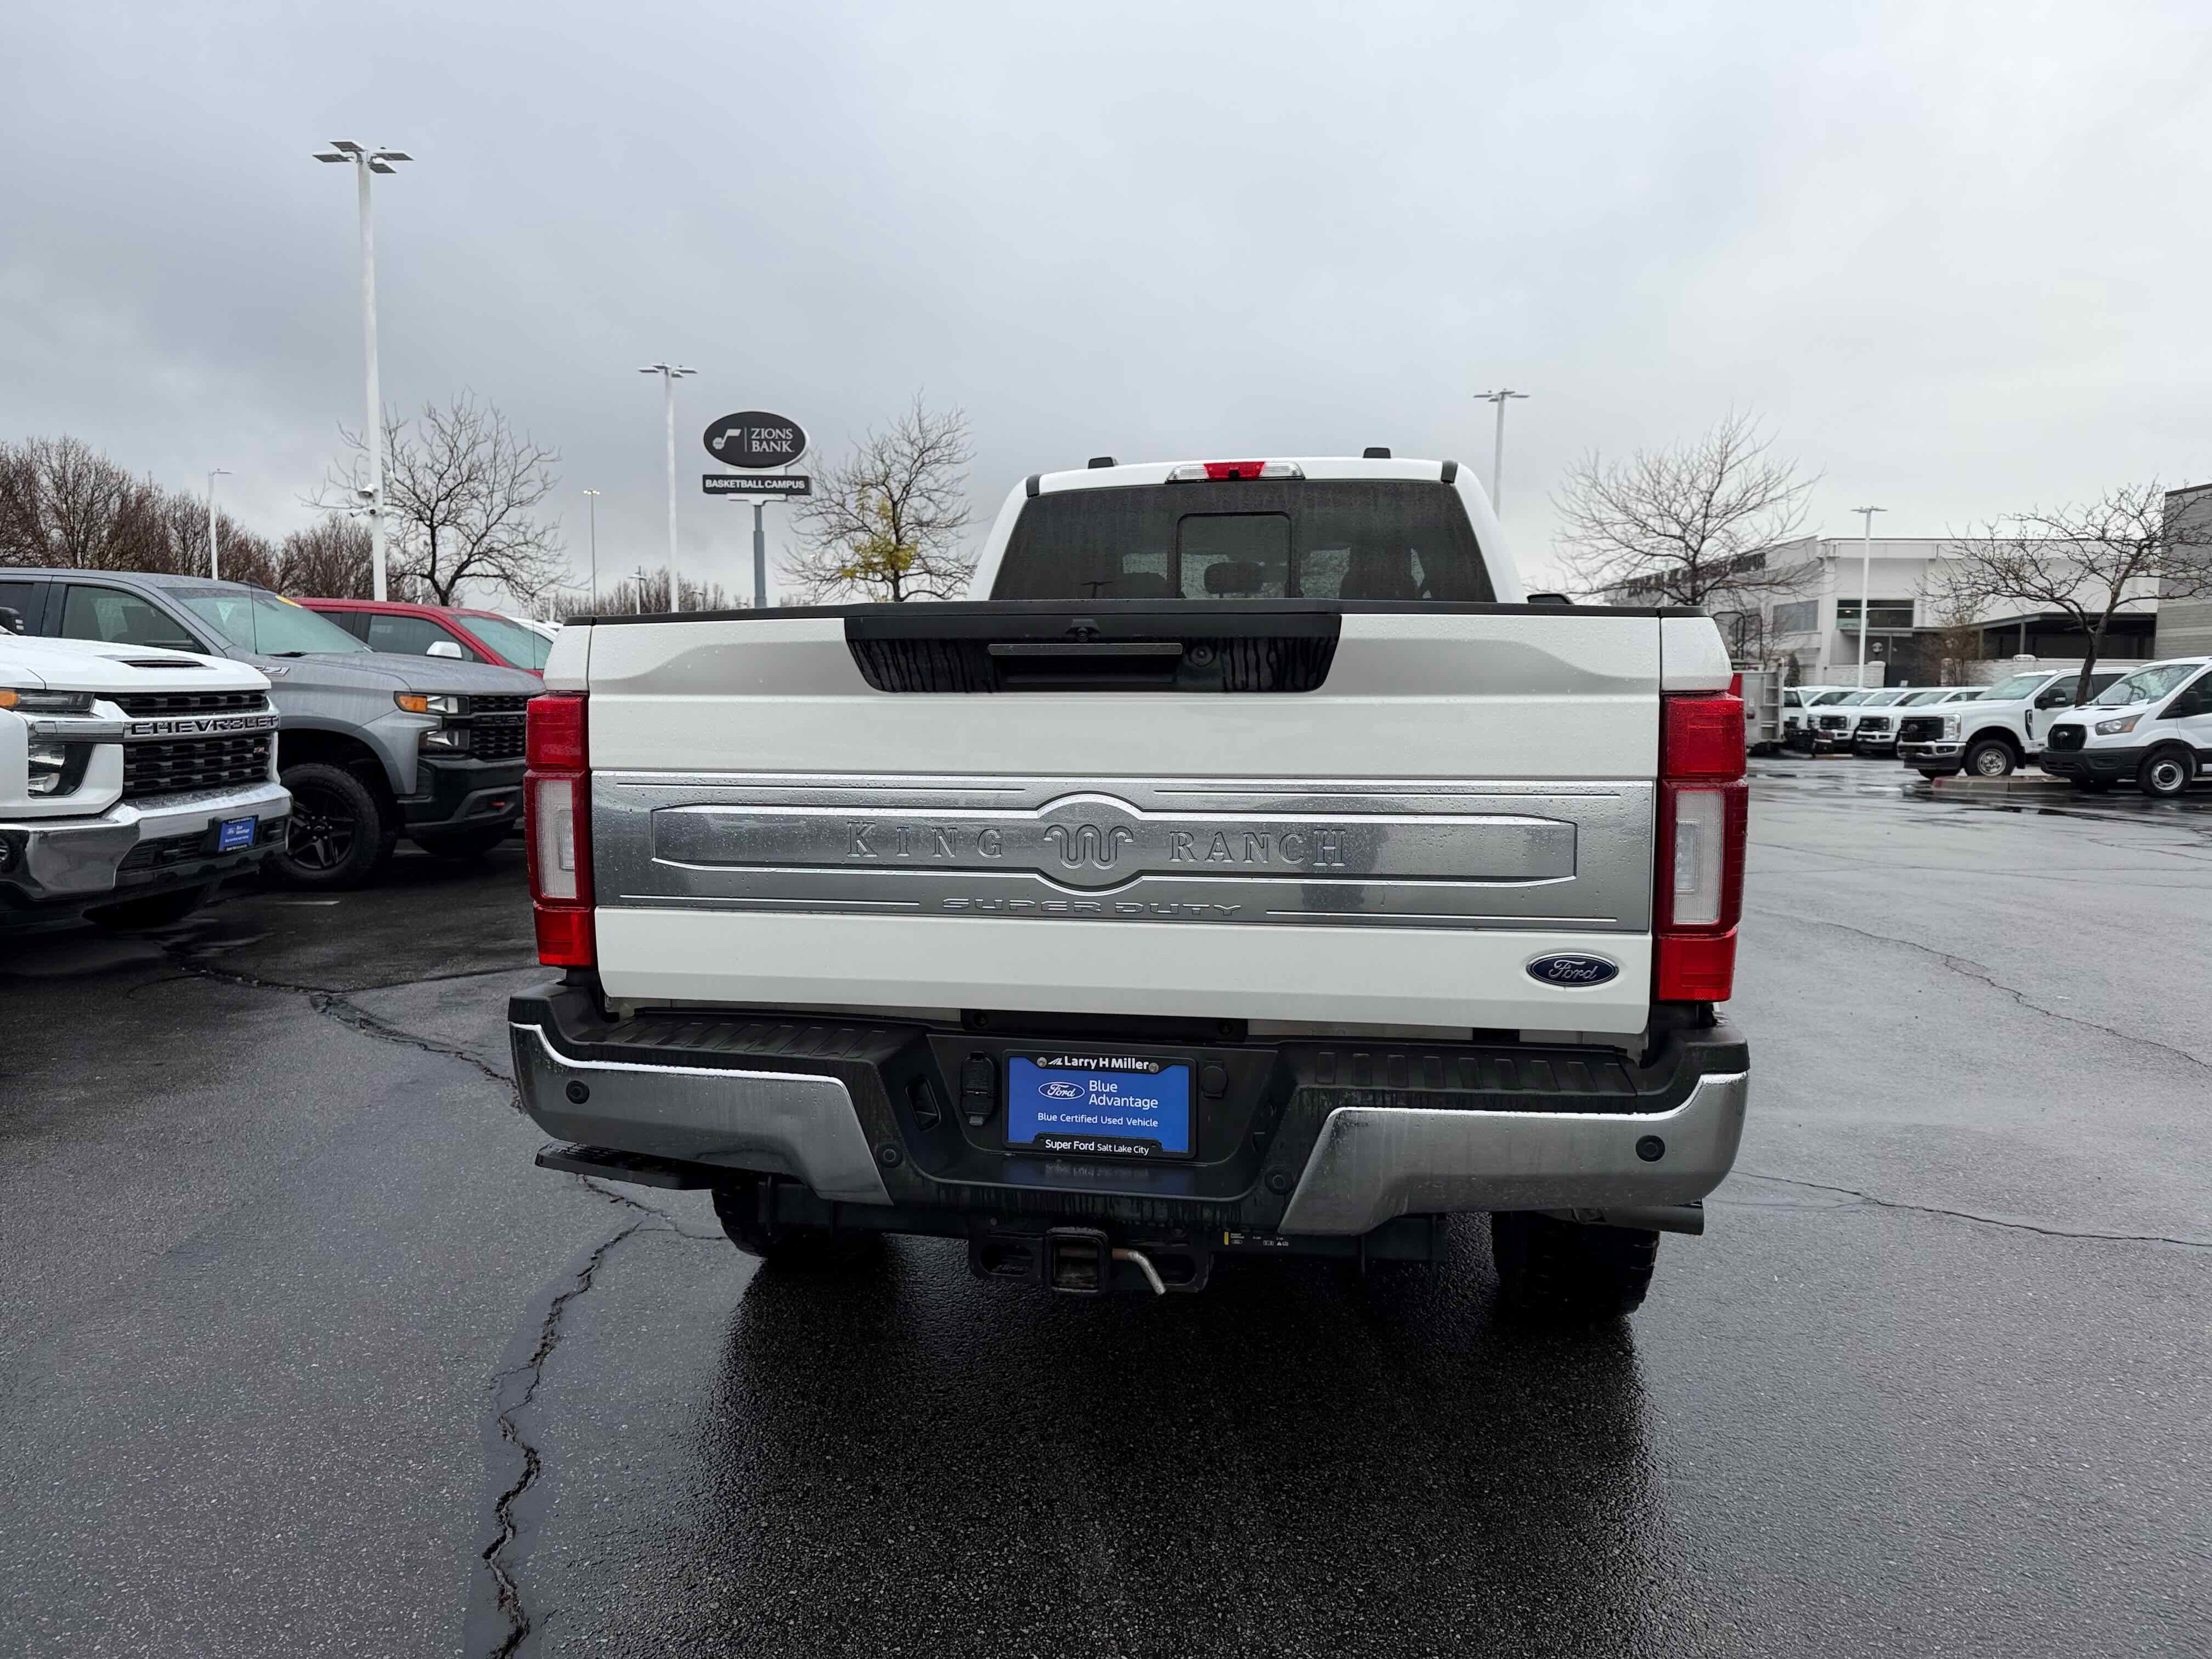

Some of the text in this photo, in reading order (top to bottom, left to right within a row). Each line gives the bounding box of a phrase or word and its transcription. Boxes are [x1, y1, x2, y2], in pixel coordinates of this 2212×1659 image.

[751, 428, 793, 439] ZIONS
[752, 441, 794, 452] BANK
[705, 479, 805, 489] BASKETBALL CAMPUS
[131, 715, 279, 736] CHEVROLET
[847, 821, 1346, 867] KING RANCH
[943, 898, 1242, 916] SUPER DUTY
[1548, 960, 1599, 979] Ford
[1064, 1056, 1149, 1070] Larry H Miller
[1047, 1084, 1076, 1097] Ford
[1088, 1080, 1118, 1093] Blue
[1088, 1094, 1159, 1110] Advantage
[1037, 1113, 1159, 1127] Blue Certified Used Vehicle
[1045, 1139, 1150, 1156] Super Ford Salt Lake City
